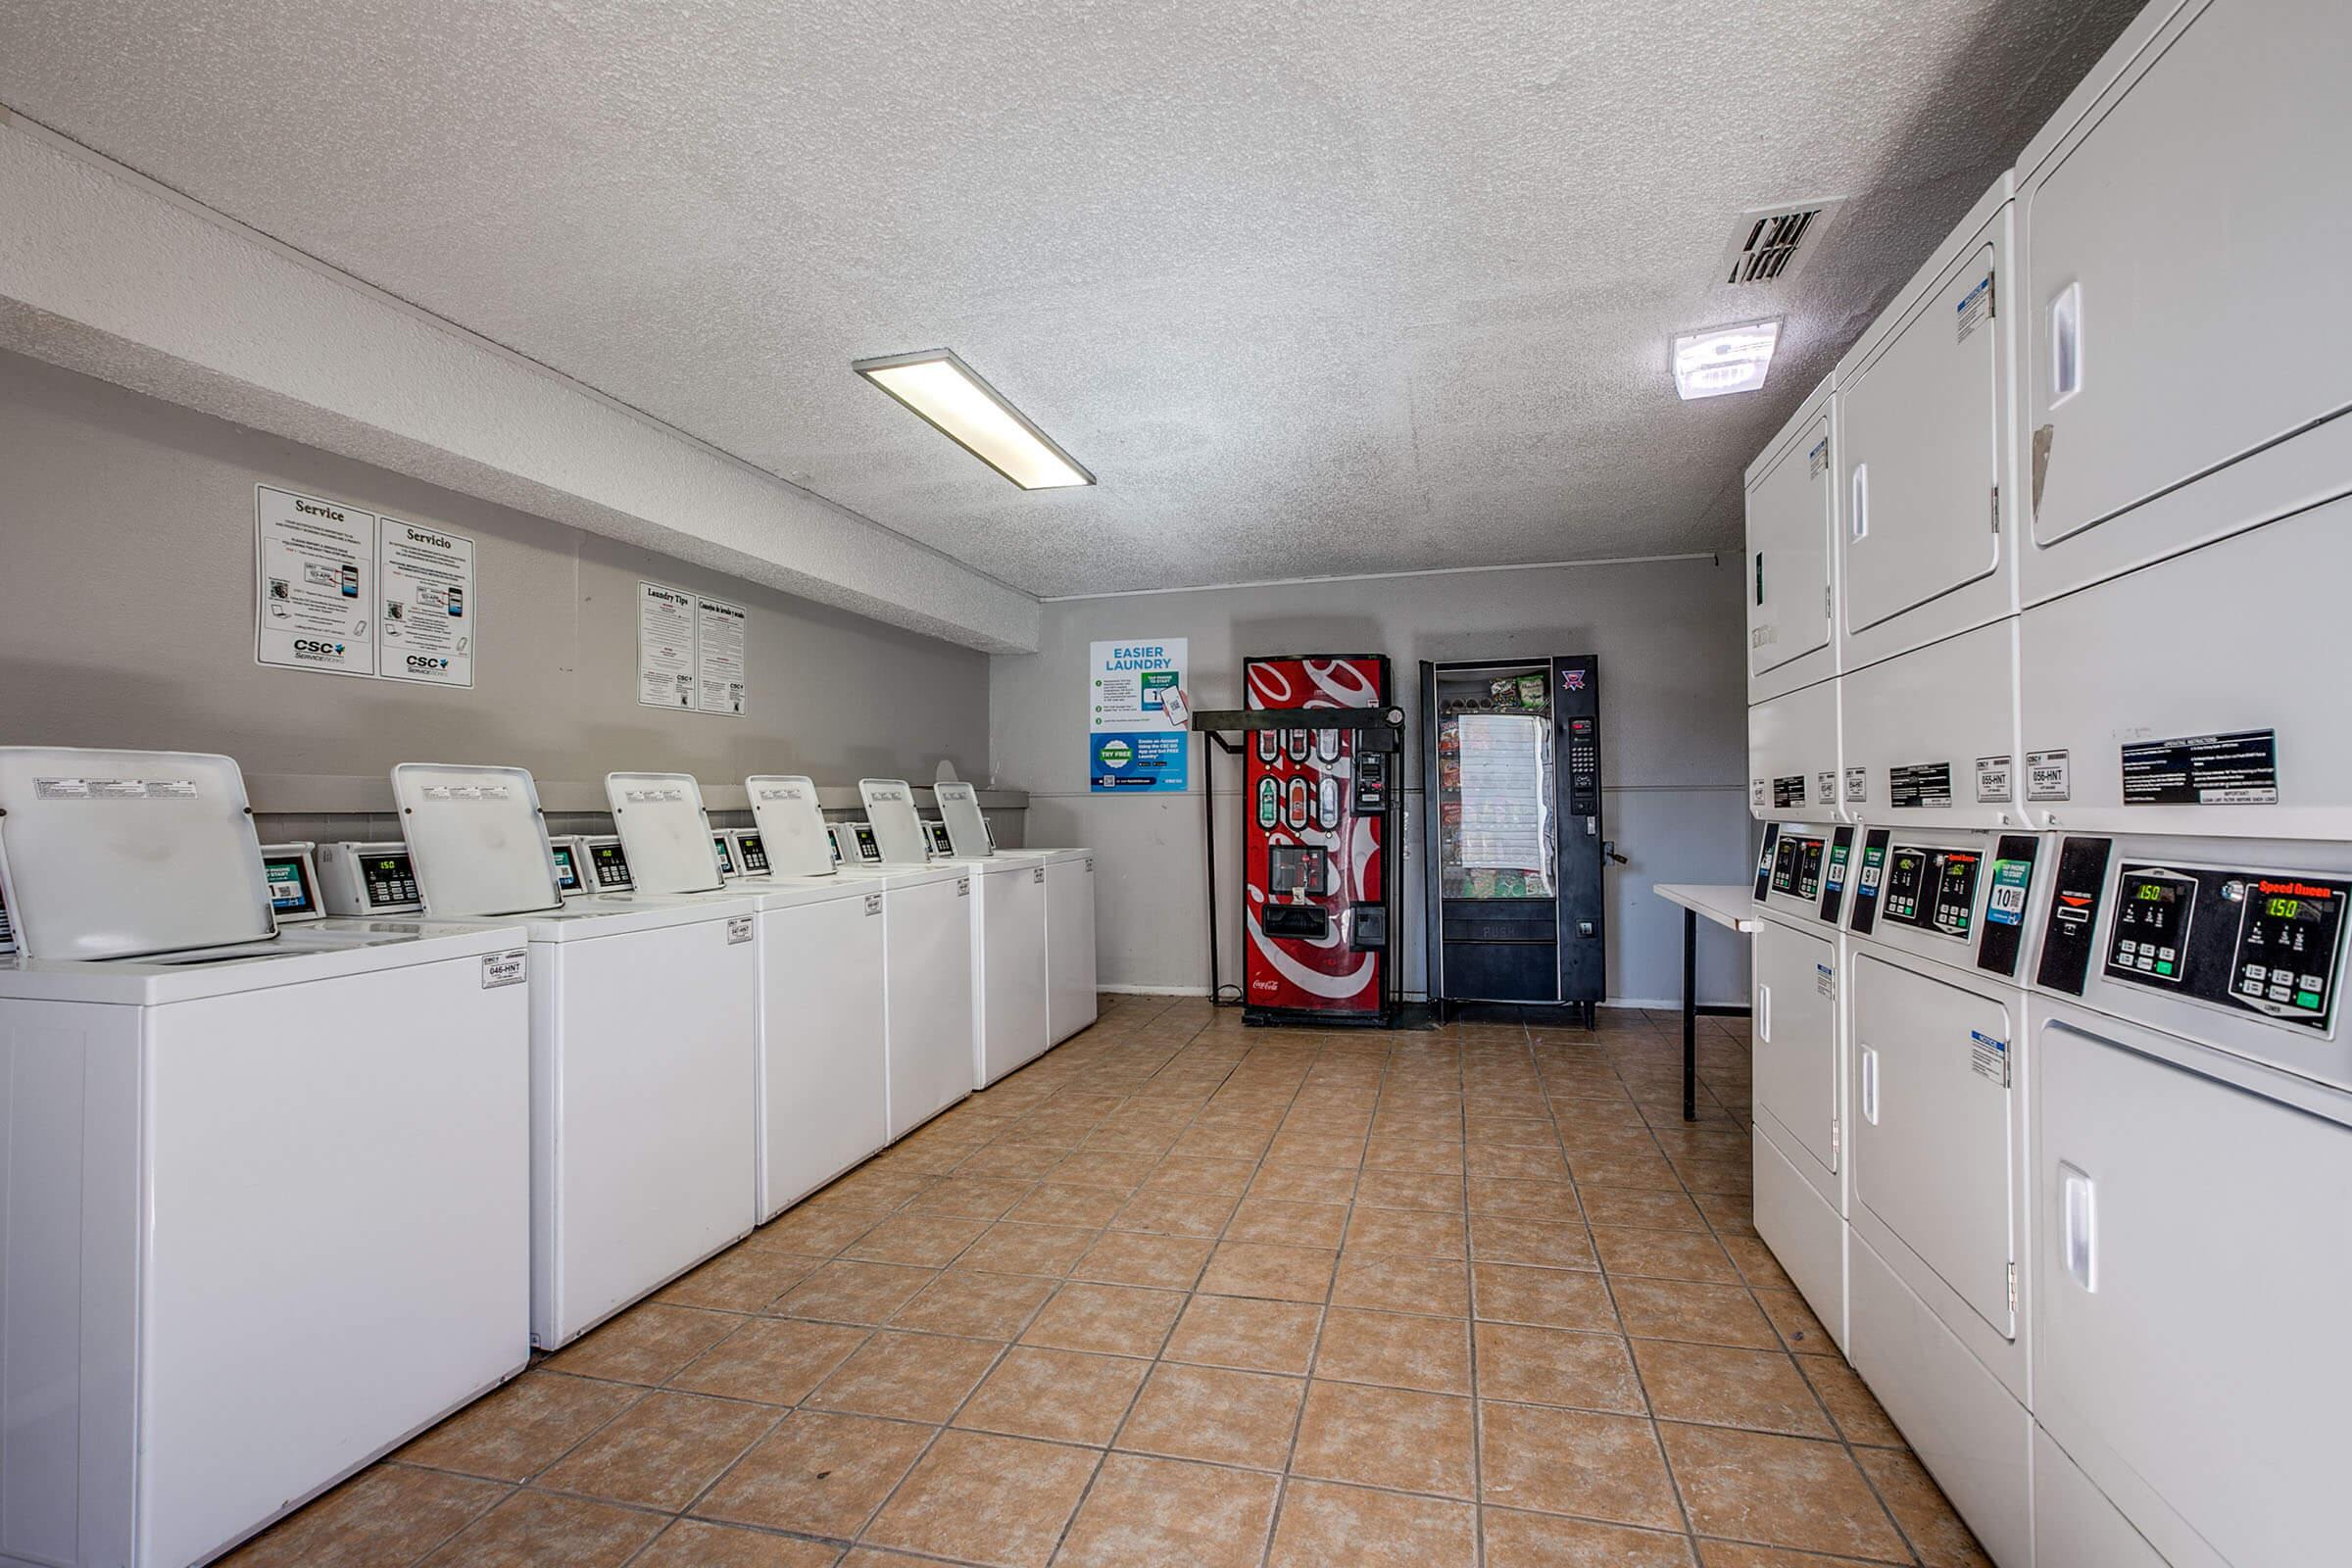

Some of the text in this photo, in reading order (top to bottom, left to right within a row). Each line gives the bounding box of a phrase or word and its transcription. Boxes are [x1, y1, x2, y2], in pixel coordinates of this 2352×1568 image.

[295, 500, 345, 522] Service
[407, 528, 452, 549] Servicio
[648, 588, 688, 606] Laundry Tips
[294, 639, 333, 654] CSC
[1113, 646, 1164, 659] EASIER
[407, 655, 439, 668] CSC
[1105, 659, 1172, 670] LAUNDRY
[1982, 774, 2006, 785] 055-HNT
[2033, 769, 2063, 781] 056-HNT
[2259, 880, 2331, 898] Speed Queen
[1997, 888, 2012, 907] 10
[1483, 926, 1515, 939] PUSH
[489, 963, 520, 975] 046-HNT
[1252, 979, 1278, 990] Coca-Cola
[2264, 1004, 2281, 1013] LOWER
